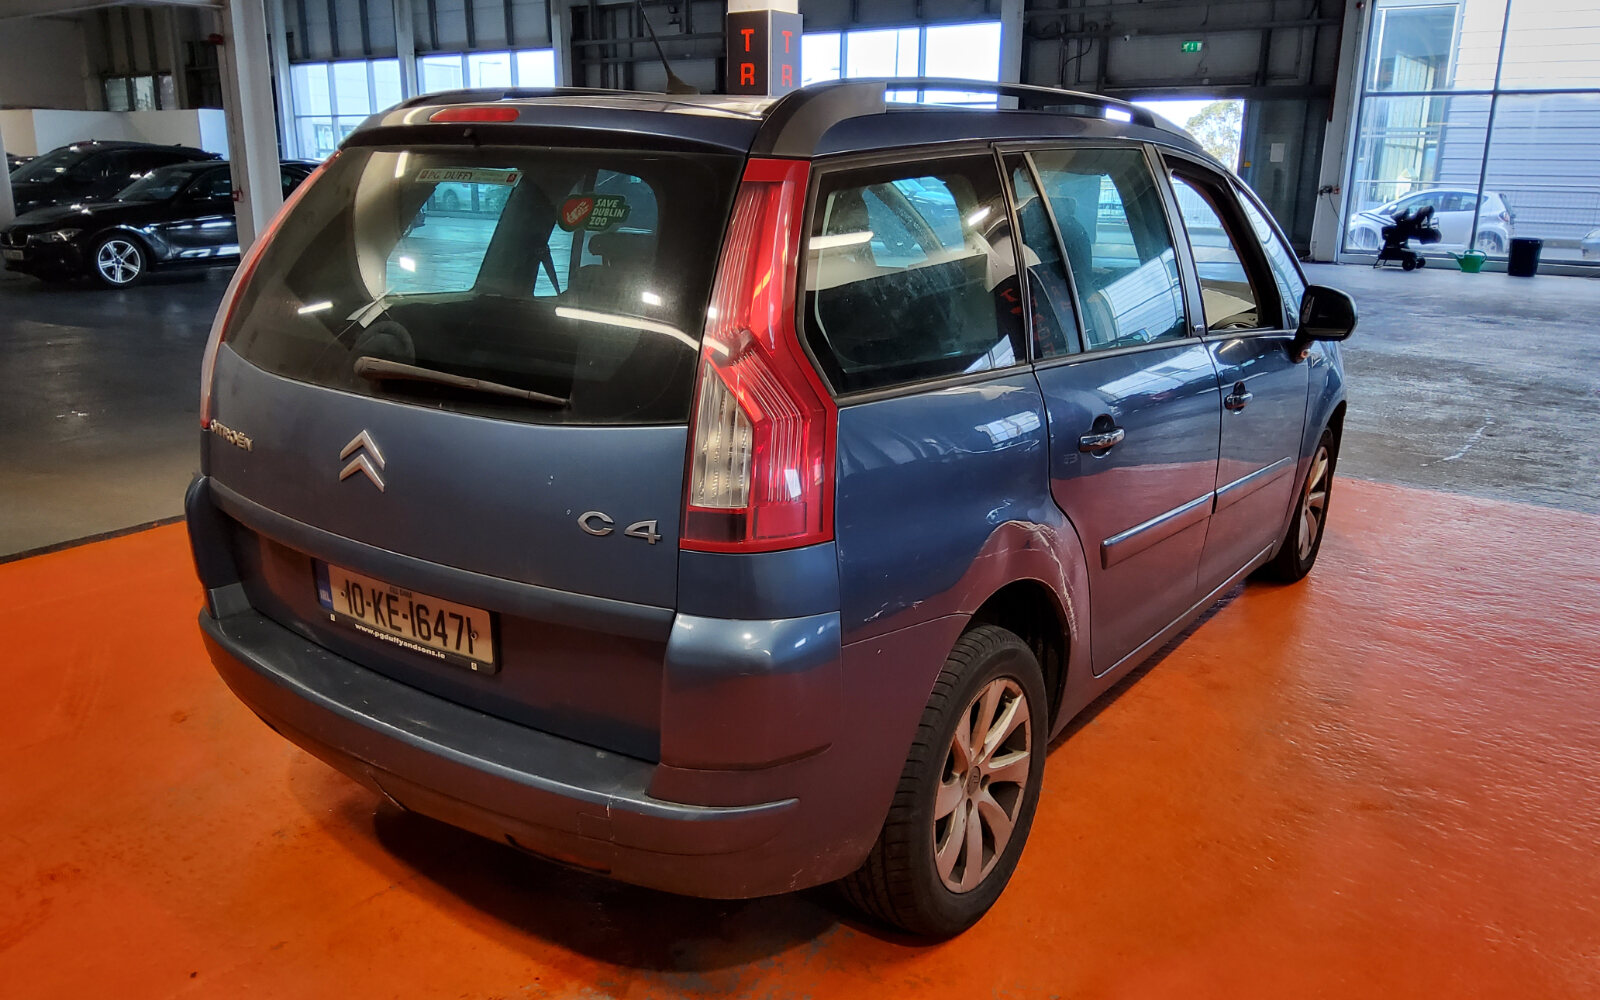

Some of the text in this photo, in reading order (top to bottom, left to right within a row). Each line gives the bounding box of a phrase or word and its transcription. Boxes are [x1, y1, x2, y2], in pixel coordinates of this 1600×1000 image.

[595, 198, 620, 208] SAVE
[592, 207, 625, 218] DUBLIN
[589, 216, 608, 226] ZOO
[354, 622, 446, 660] www.pgduffyandsons.ie
